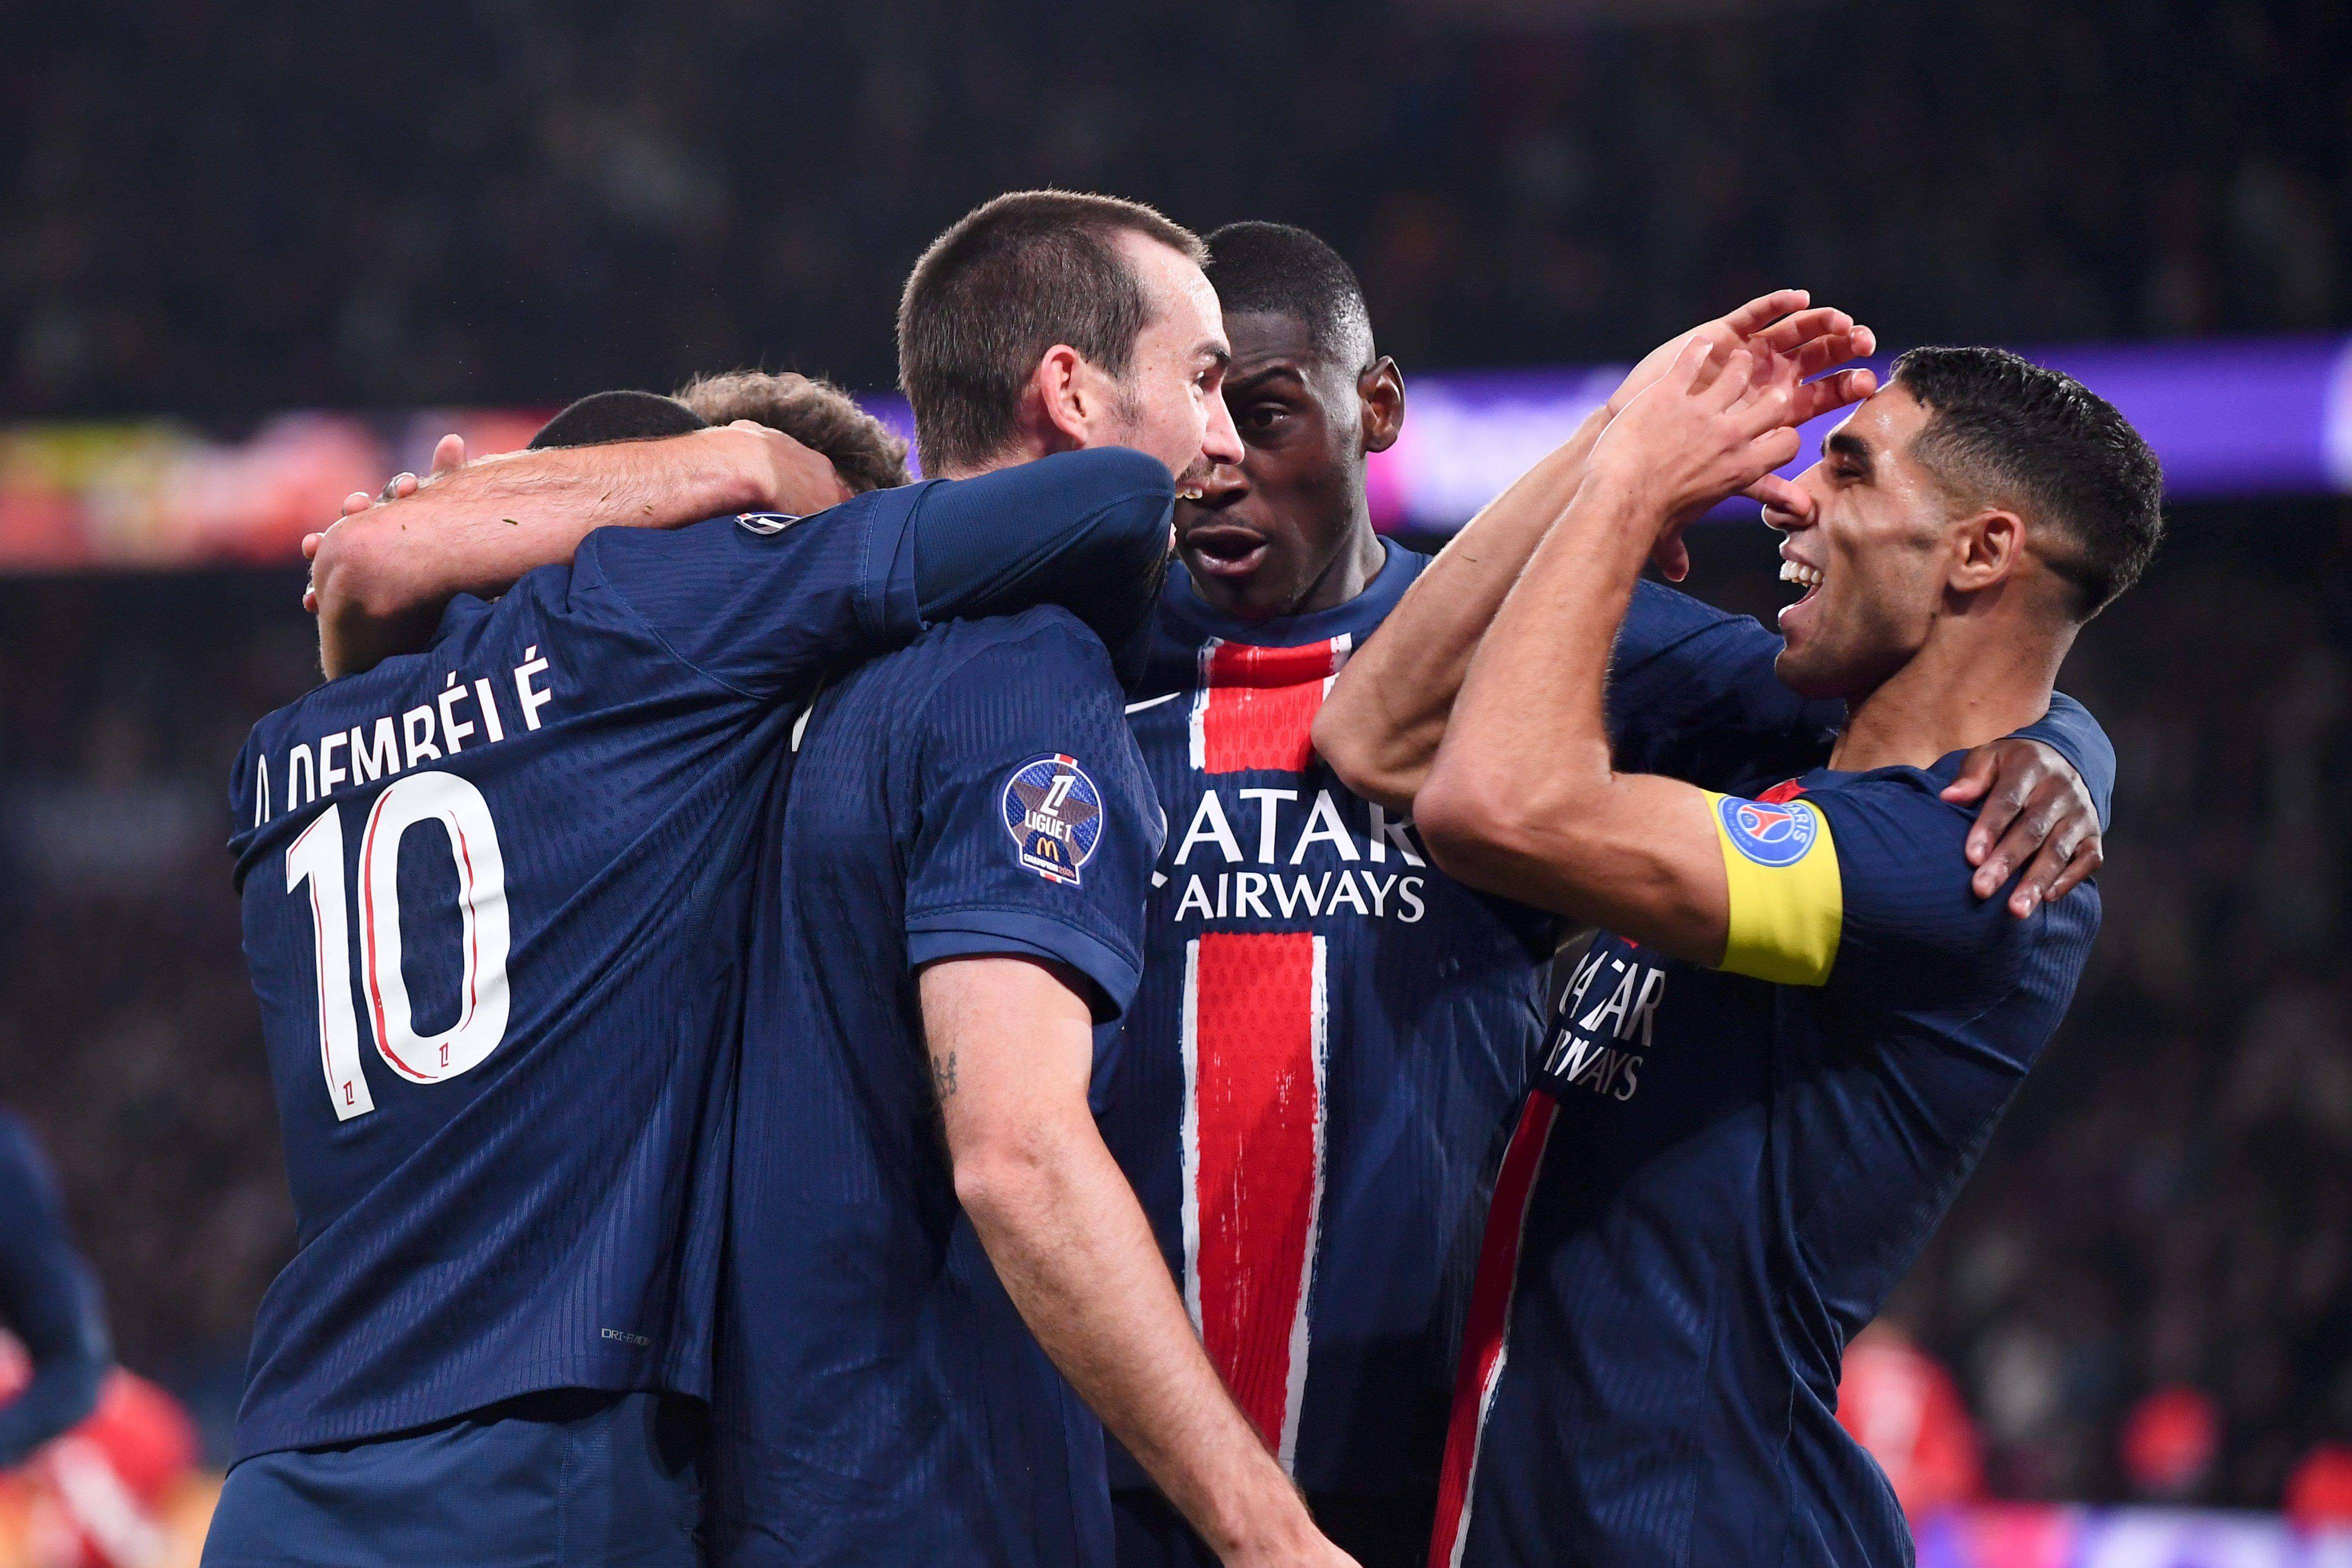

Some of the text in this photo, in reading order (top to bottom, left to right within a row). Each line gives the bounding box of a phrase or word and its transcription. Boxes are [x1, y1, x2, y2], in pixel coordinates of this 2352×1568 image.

[1025, 809, 1072, 842] LIGUE 1
[1156, 789, 1427, 870] ATAR
[1174, 869, 1425, 923] AIRWAYS
[286, 770, 511, 1121] 10
